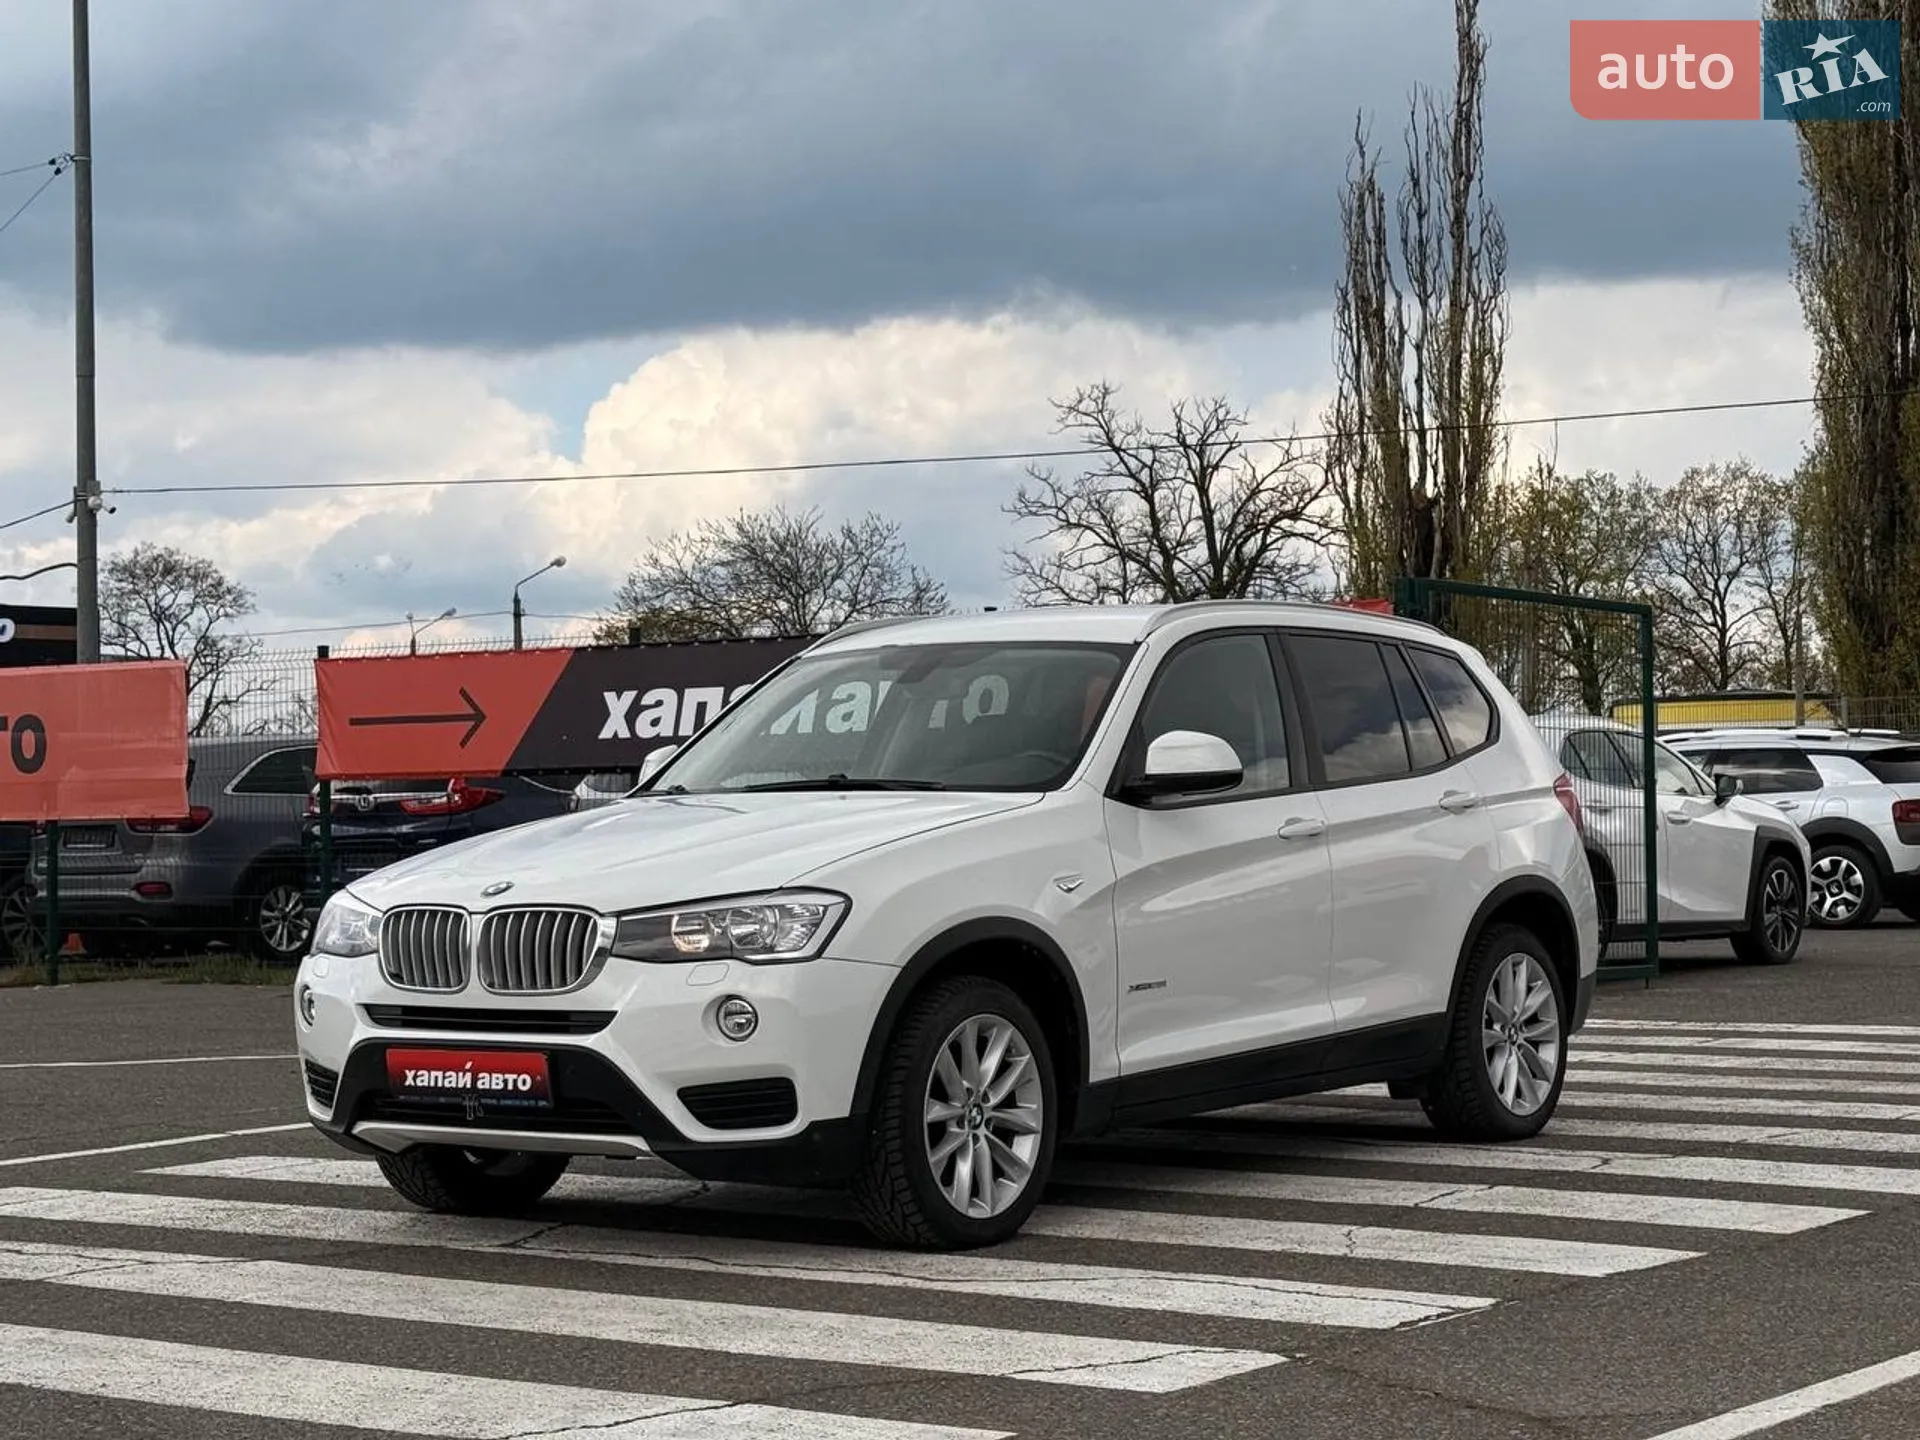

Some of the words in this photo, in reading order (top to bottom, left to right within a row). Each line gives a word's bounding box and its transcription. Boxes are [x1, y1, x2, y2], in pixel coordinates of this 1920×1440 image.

[597, 683, 820, 740] хап
[0, 713, 48, 775] о
[404, 1060, 473, 1089] хапай
[476, 1071, 532, 1092] авто
